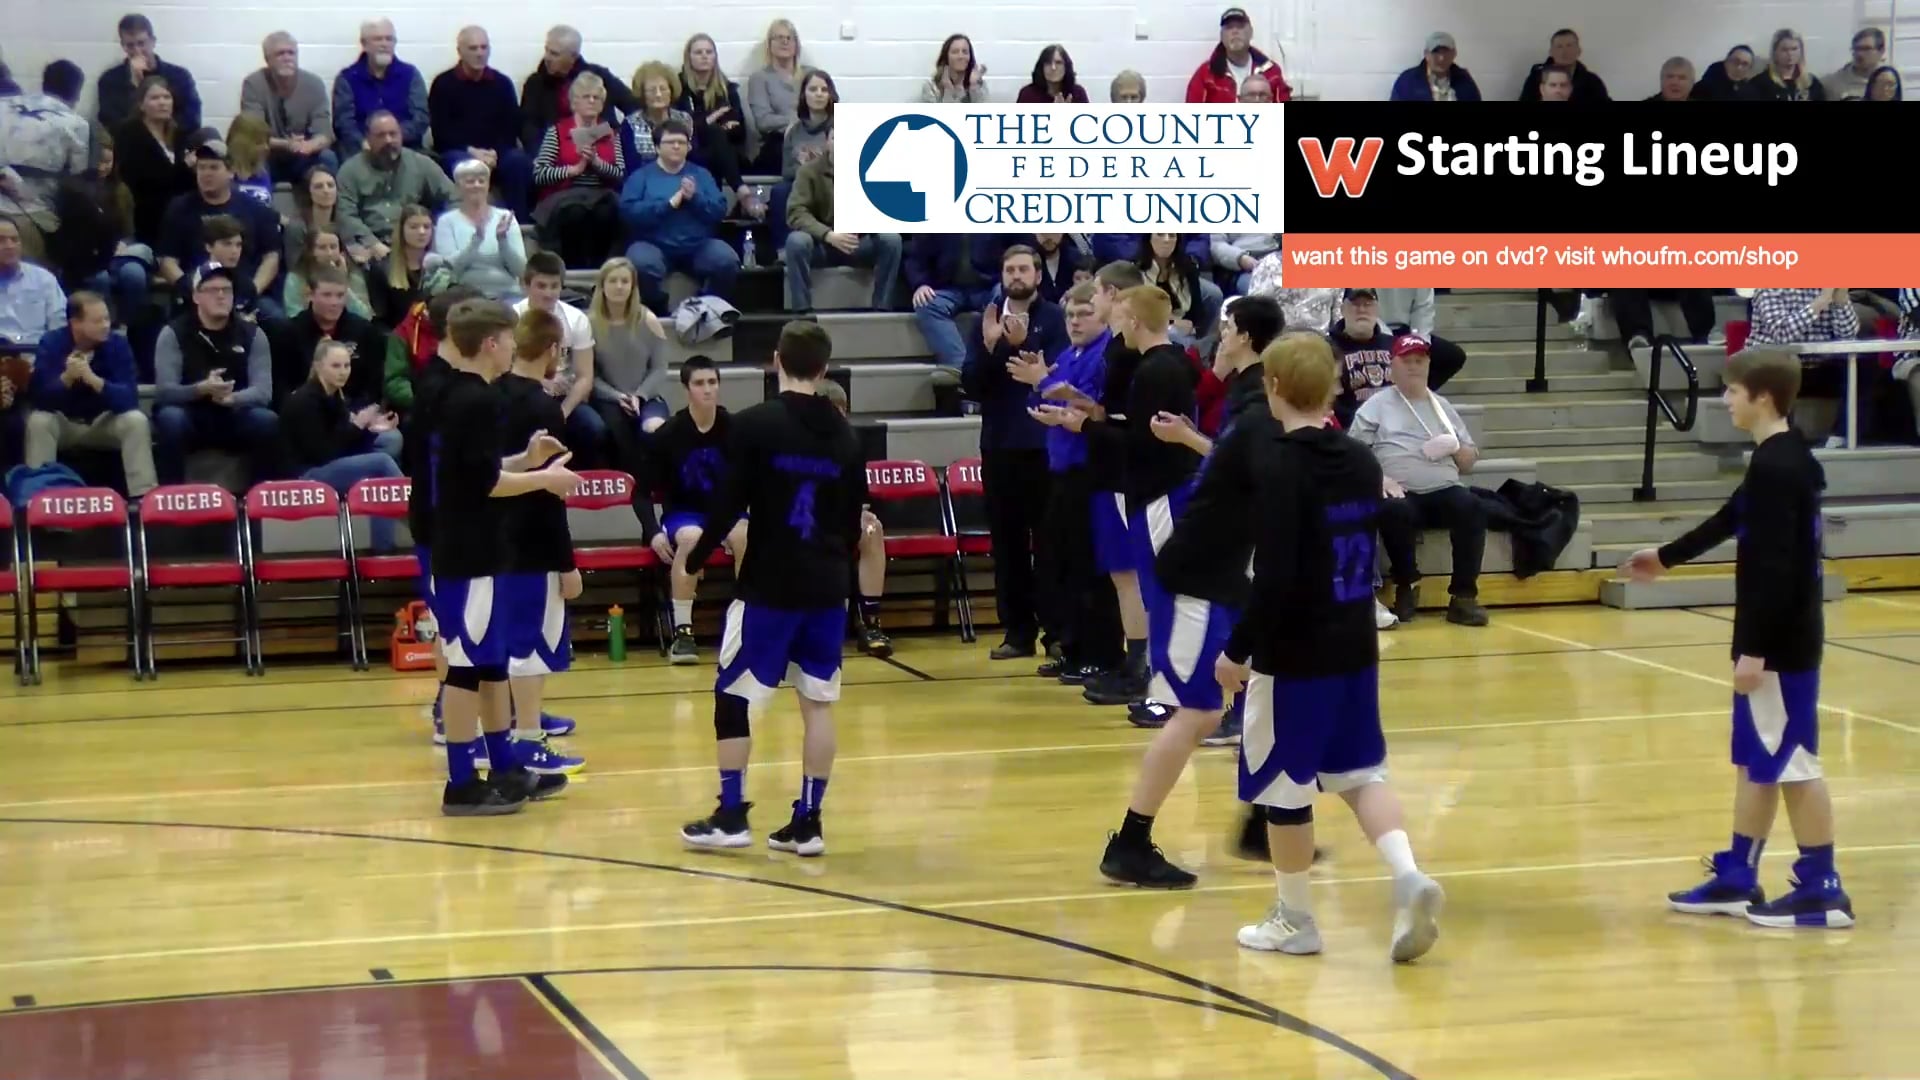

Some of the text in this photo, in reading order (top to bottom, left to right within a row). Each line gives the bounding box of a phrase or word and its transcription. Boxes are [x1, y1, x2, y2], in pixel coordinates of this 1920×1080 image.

[865, 466, 926, 485] TIGERS
[360, 484, 412, 503] TIGER
[566, 477, 626, 496] GERS
[42, 495, 114, 515] TIGERS
[154, 491, 223, 511] TIGERS
[259, 487, 326, 507] TIGERS
[1332, 532, 1371, 601] 12
